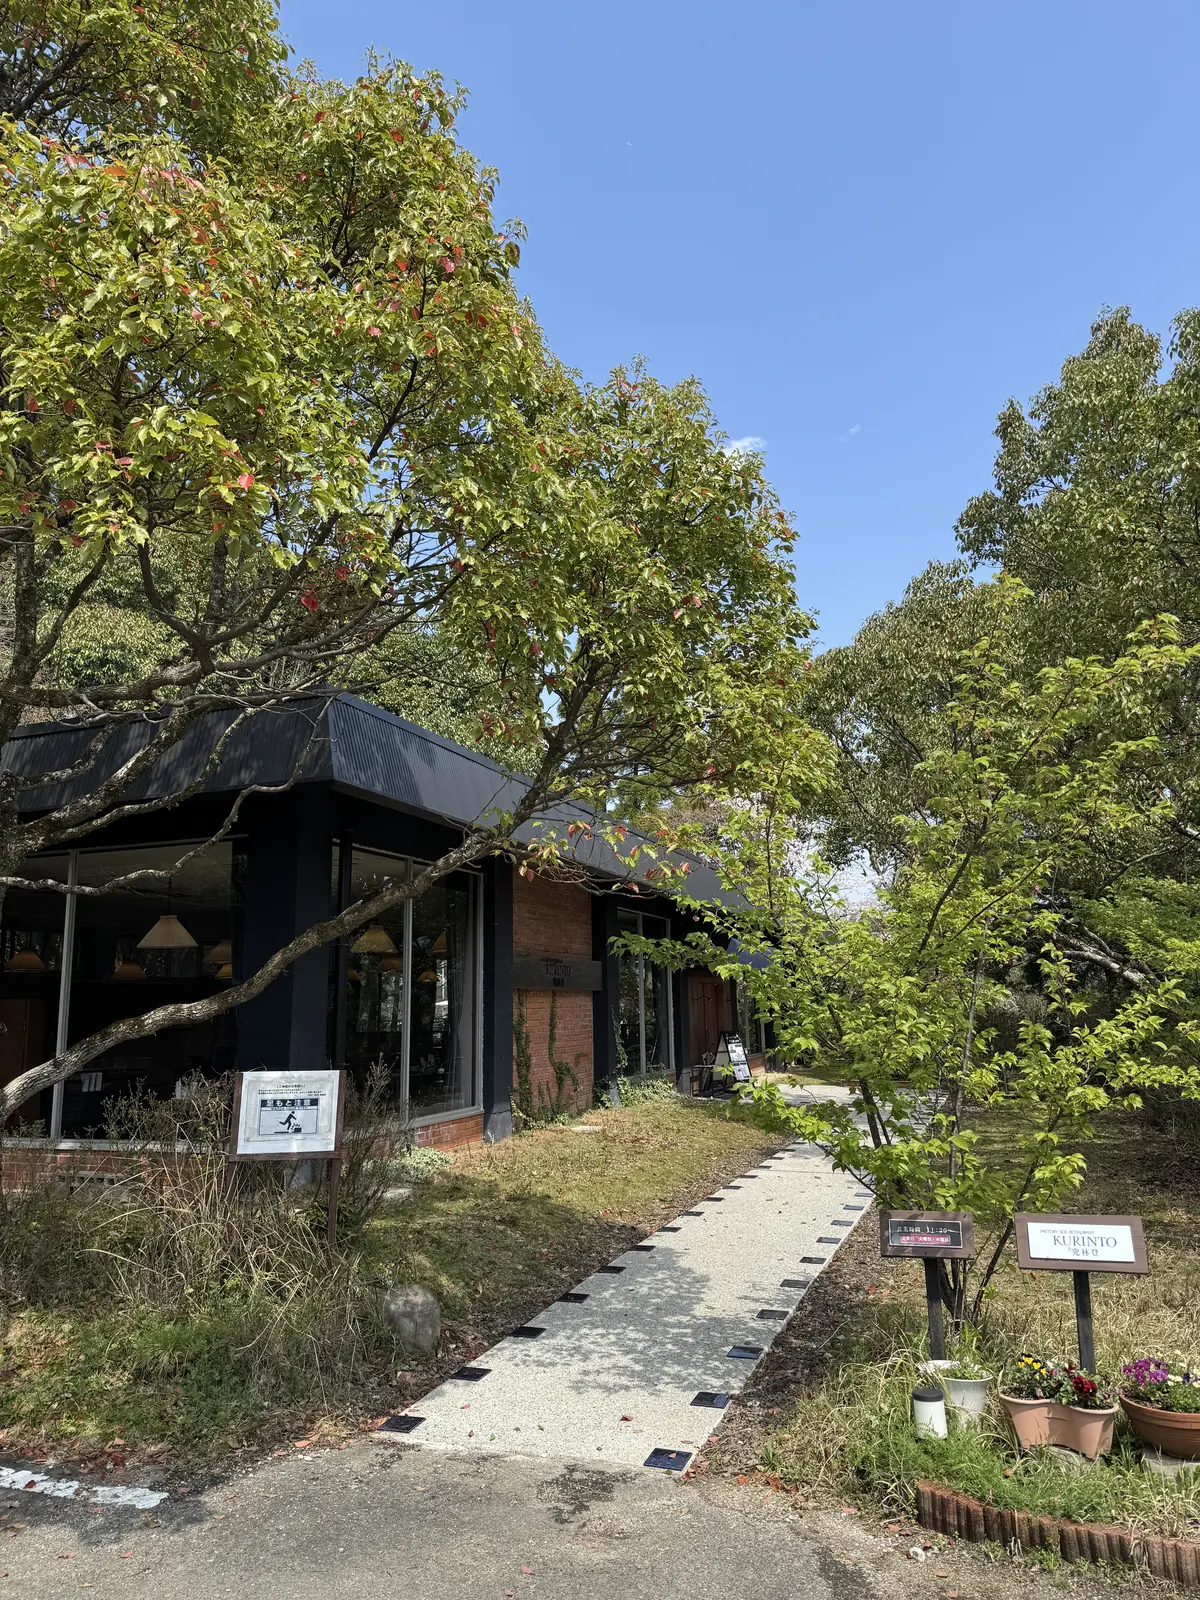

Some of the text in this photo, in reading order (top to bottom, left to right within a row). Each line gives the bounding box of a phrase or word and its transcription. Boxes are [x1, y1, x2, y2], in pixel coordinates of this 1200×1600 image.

[266, 1099, 311, 1107] 足もと注意
[1053, 1235, 1117, 1248] KURINTO
